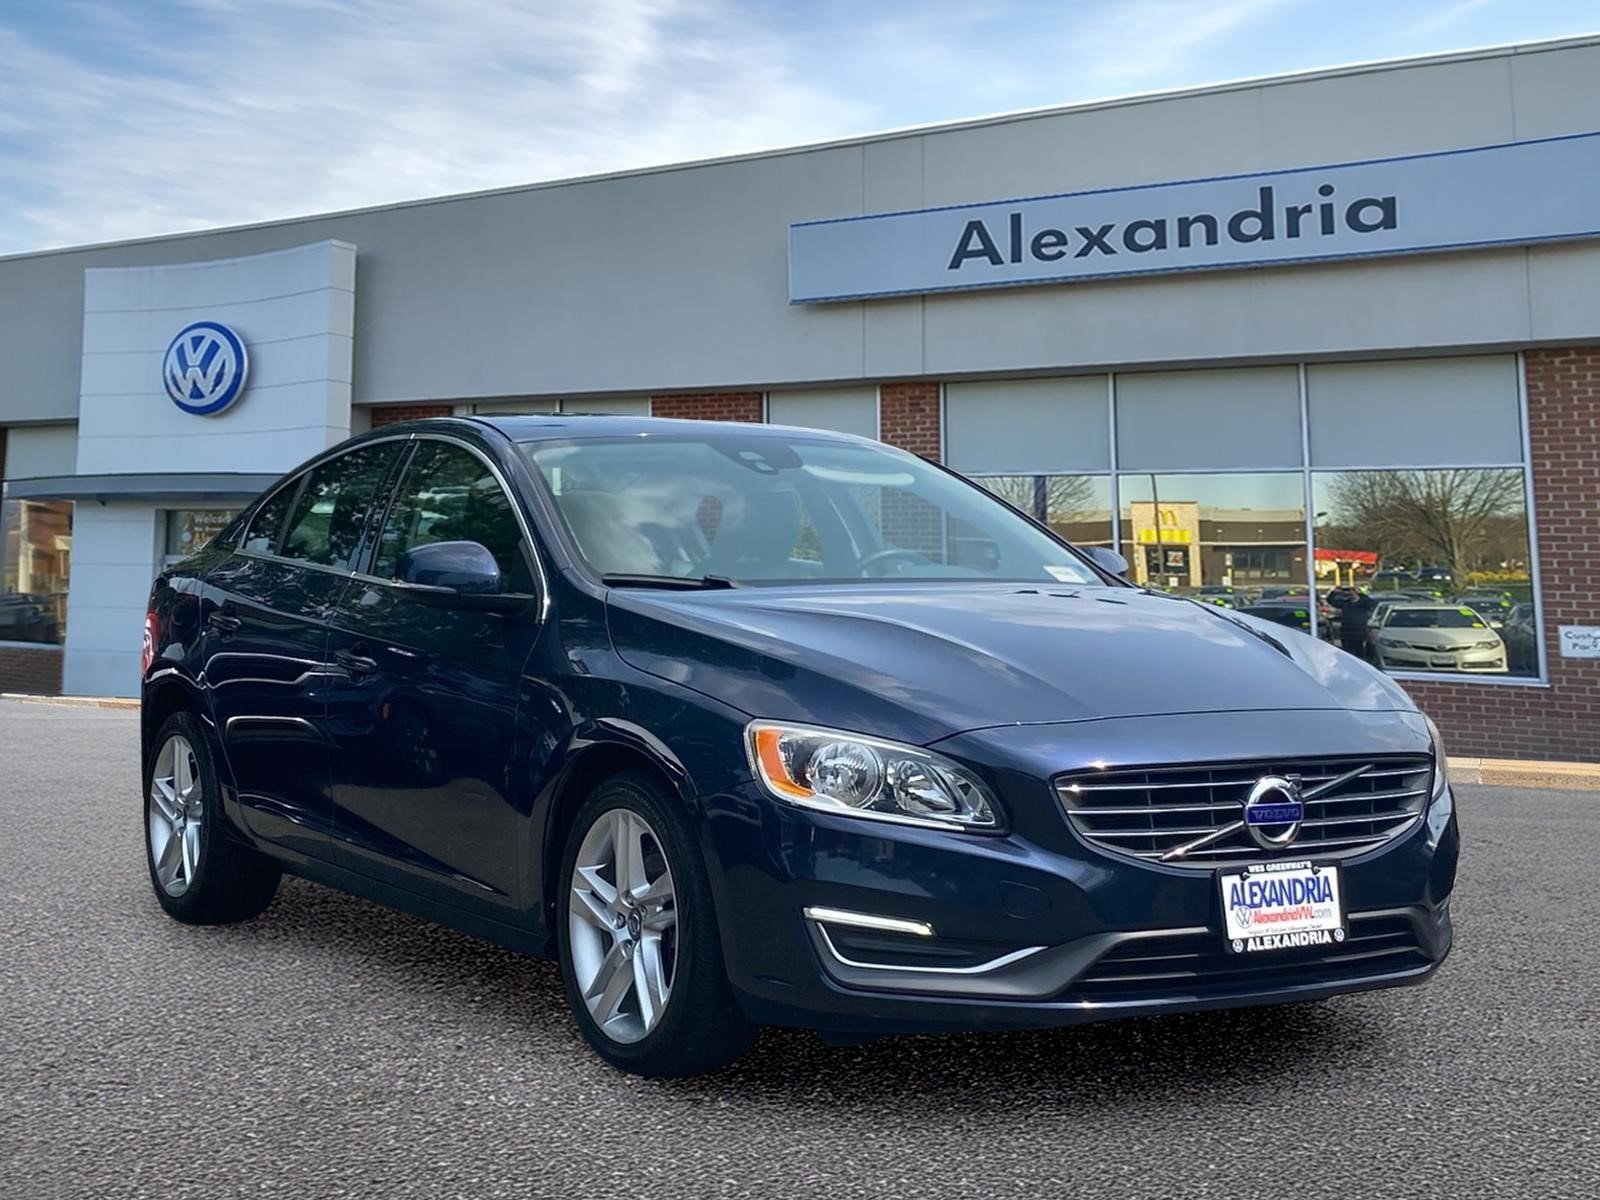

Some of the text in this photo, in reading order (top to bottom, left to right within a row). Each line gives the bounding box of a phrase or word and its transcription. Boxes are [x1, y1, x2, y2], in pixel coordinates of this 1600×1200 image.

[947, 183, 1398, 271] Alexandria
[1251, 807, 1300, 821] VOLVO
[1229, 875, 1334, 911] ALEXANDRIA
[1246, 931, 1333, 952] ALEXANDRIA
